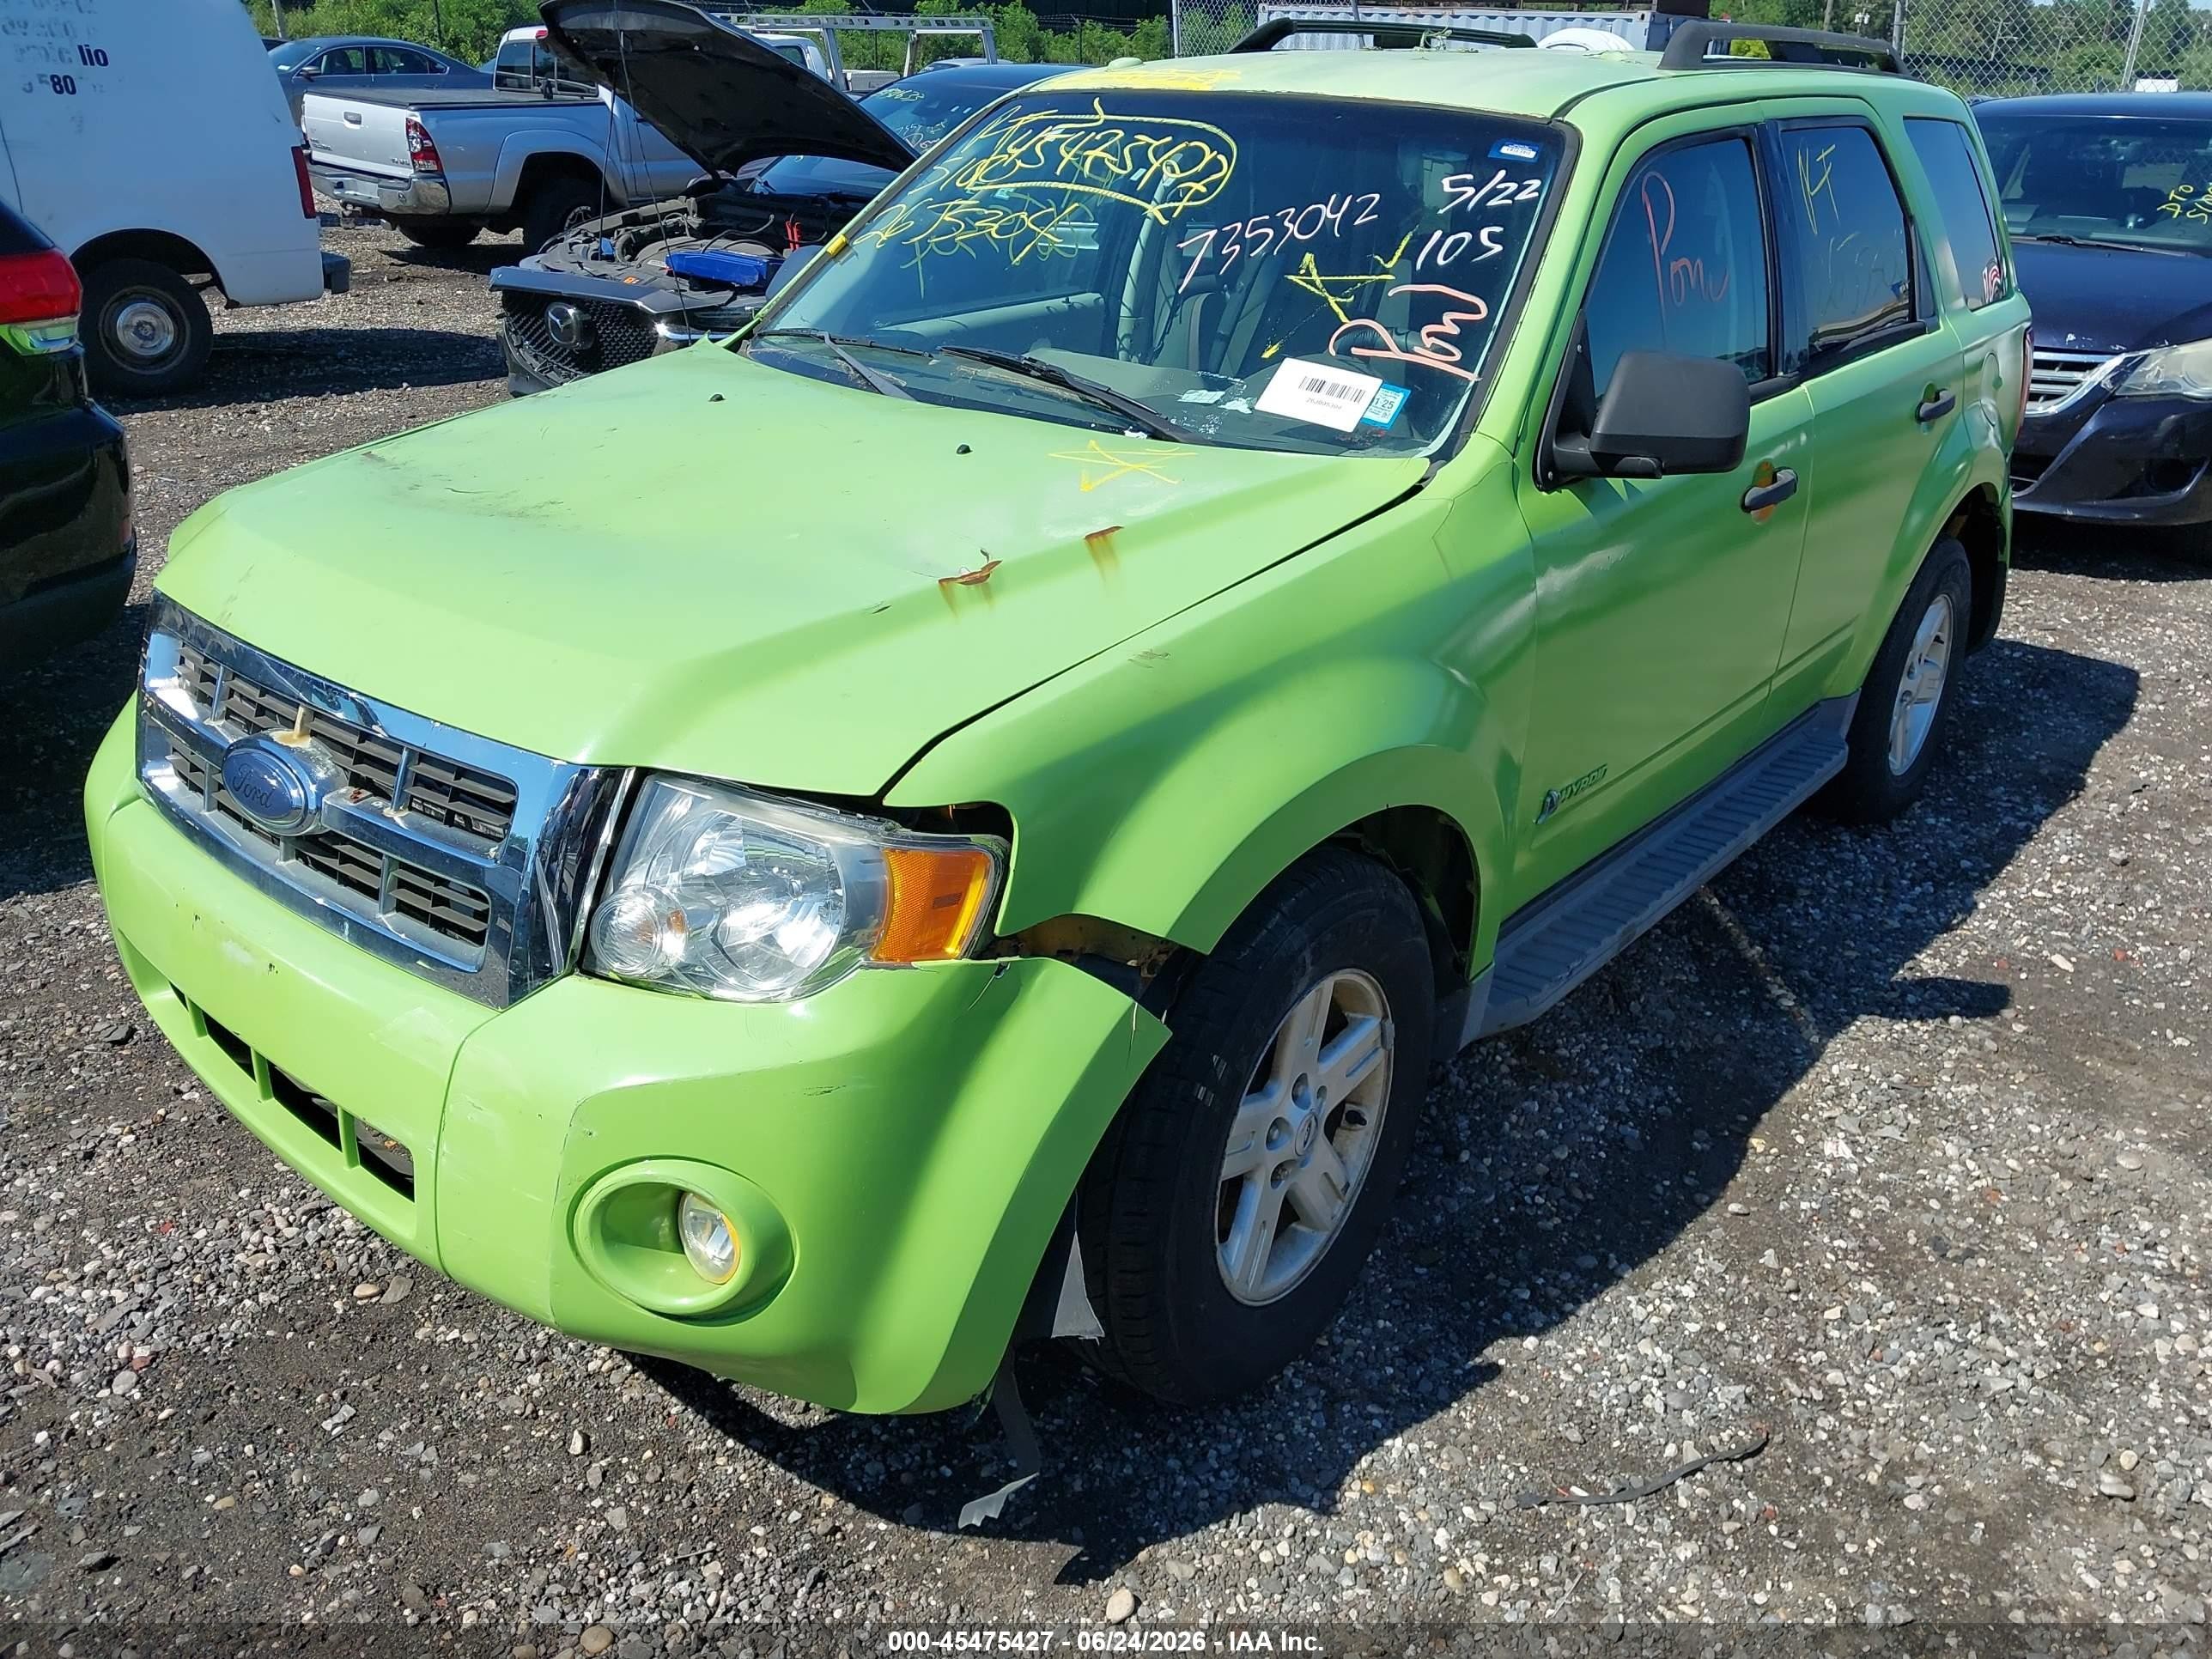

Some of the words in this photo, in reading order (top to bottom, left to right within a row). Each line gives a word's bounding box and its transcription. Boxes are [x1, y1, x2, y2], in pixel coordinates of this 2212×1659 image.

[1437, 168, 1541, 216] 5/22
[1177, 193, 1381, 295] 7353042
[1415, 227, 1504, 271] 105
[232, 763, 275, 808] Ford
